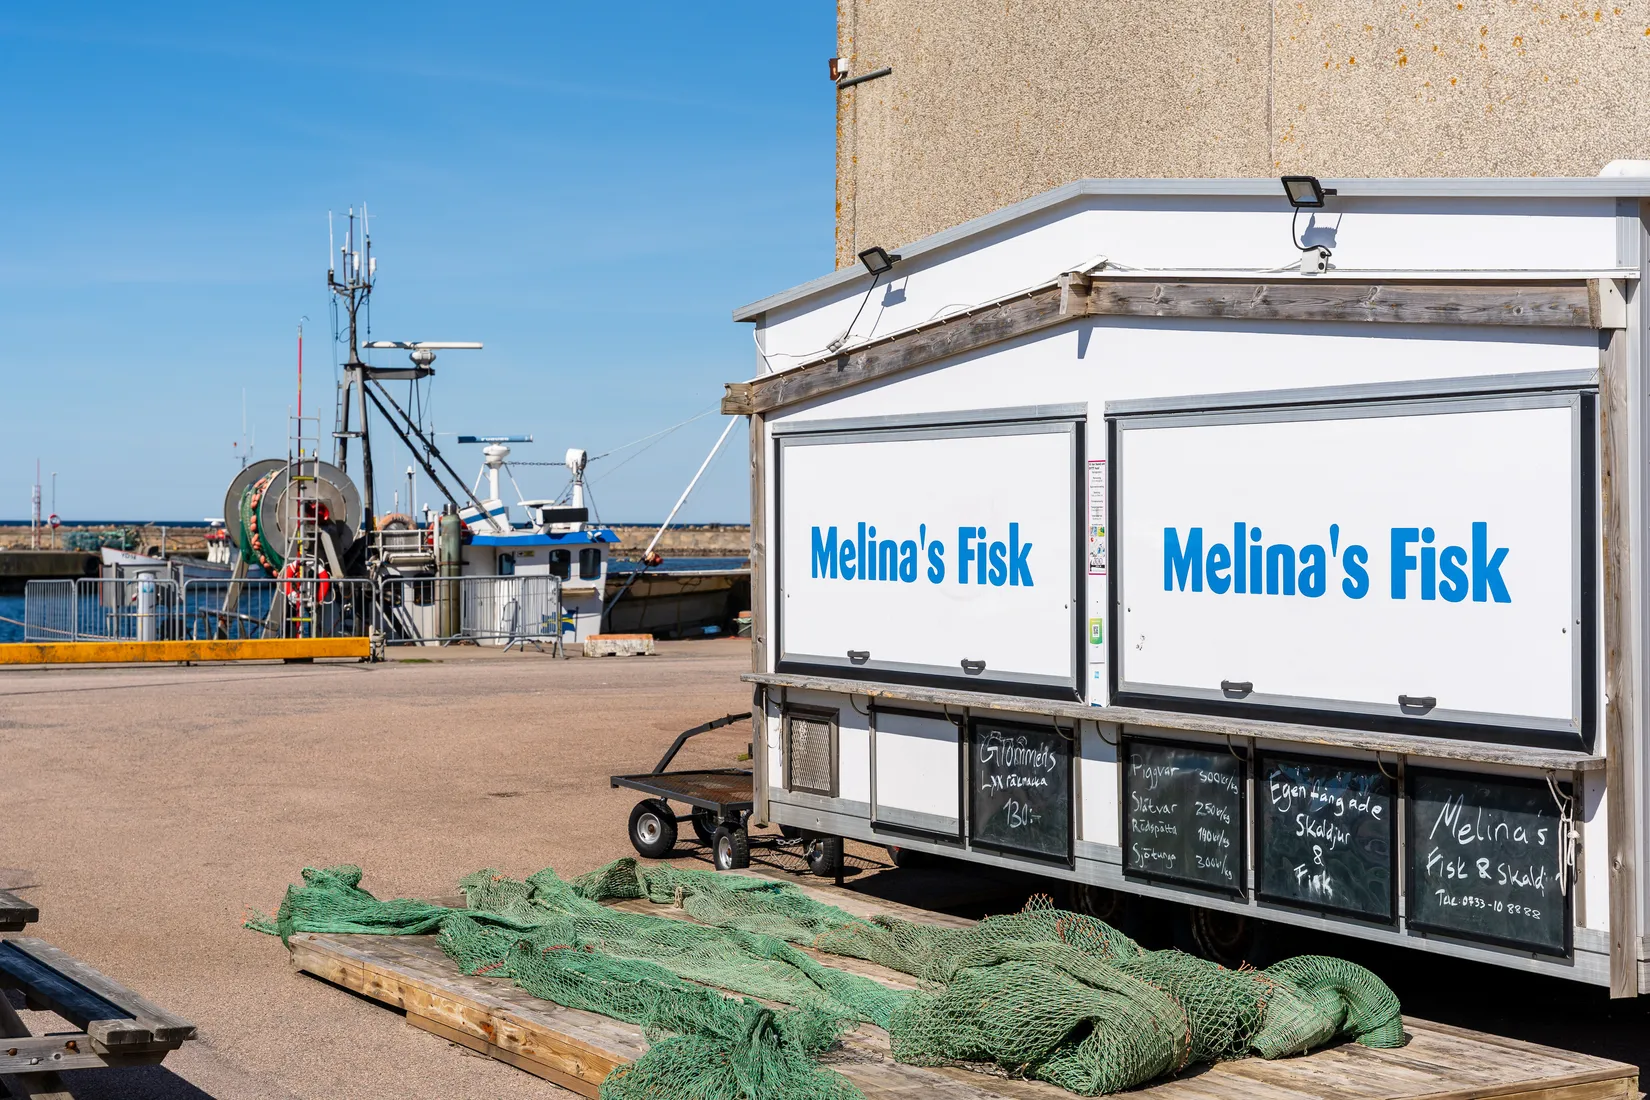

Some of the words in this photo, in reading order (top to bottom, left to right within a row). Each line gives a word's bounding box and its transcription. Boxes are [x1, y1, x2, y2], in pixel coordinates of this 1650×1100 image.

[812, 522, 944, 584] Melina's
[958, 522, 1033, 586] Fisk
[1164, 522, 1369, 599] Melina's
[1391, 522, 1512, 603] Fisk
[1131, 754, 1180, 791] Piggvar
[1295, 813, 1351, 850] Skaldjur
[1429, 793, 1548, 846] Melina's
[1313, 844, 1325, 867] &
[1426, 846, 1468, 880] Fisk
[1476, 857, 1492, 880] &
